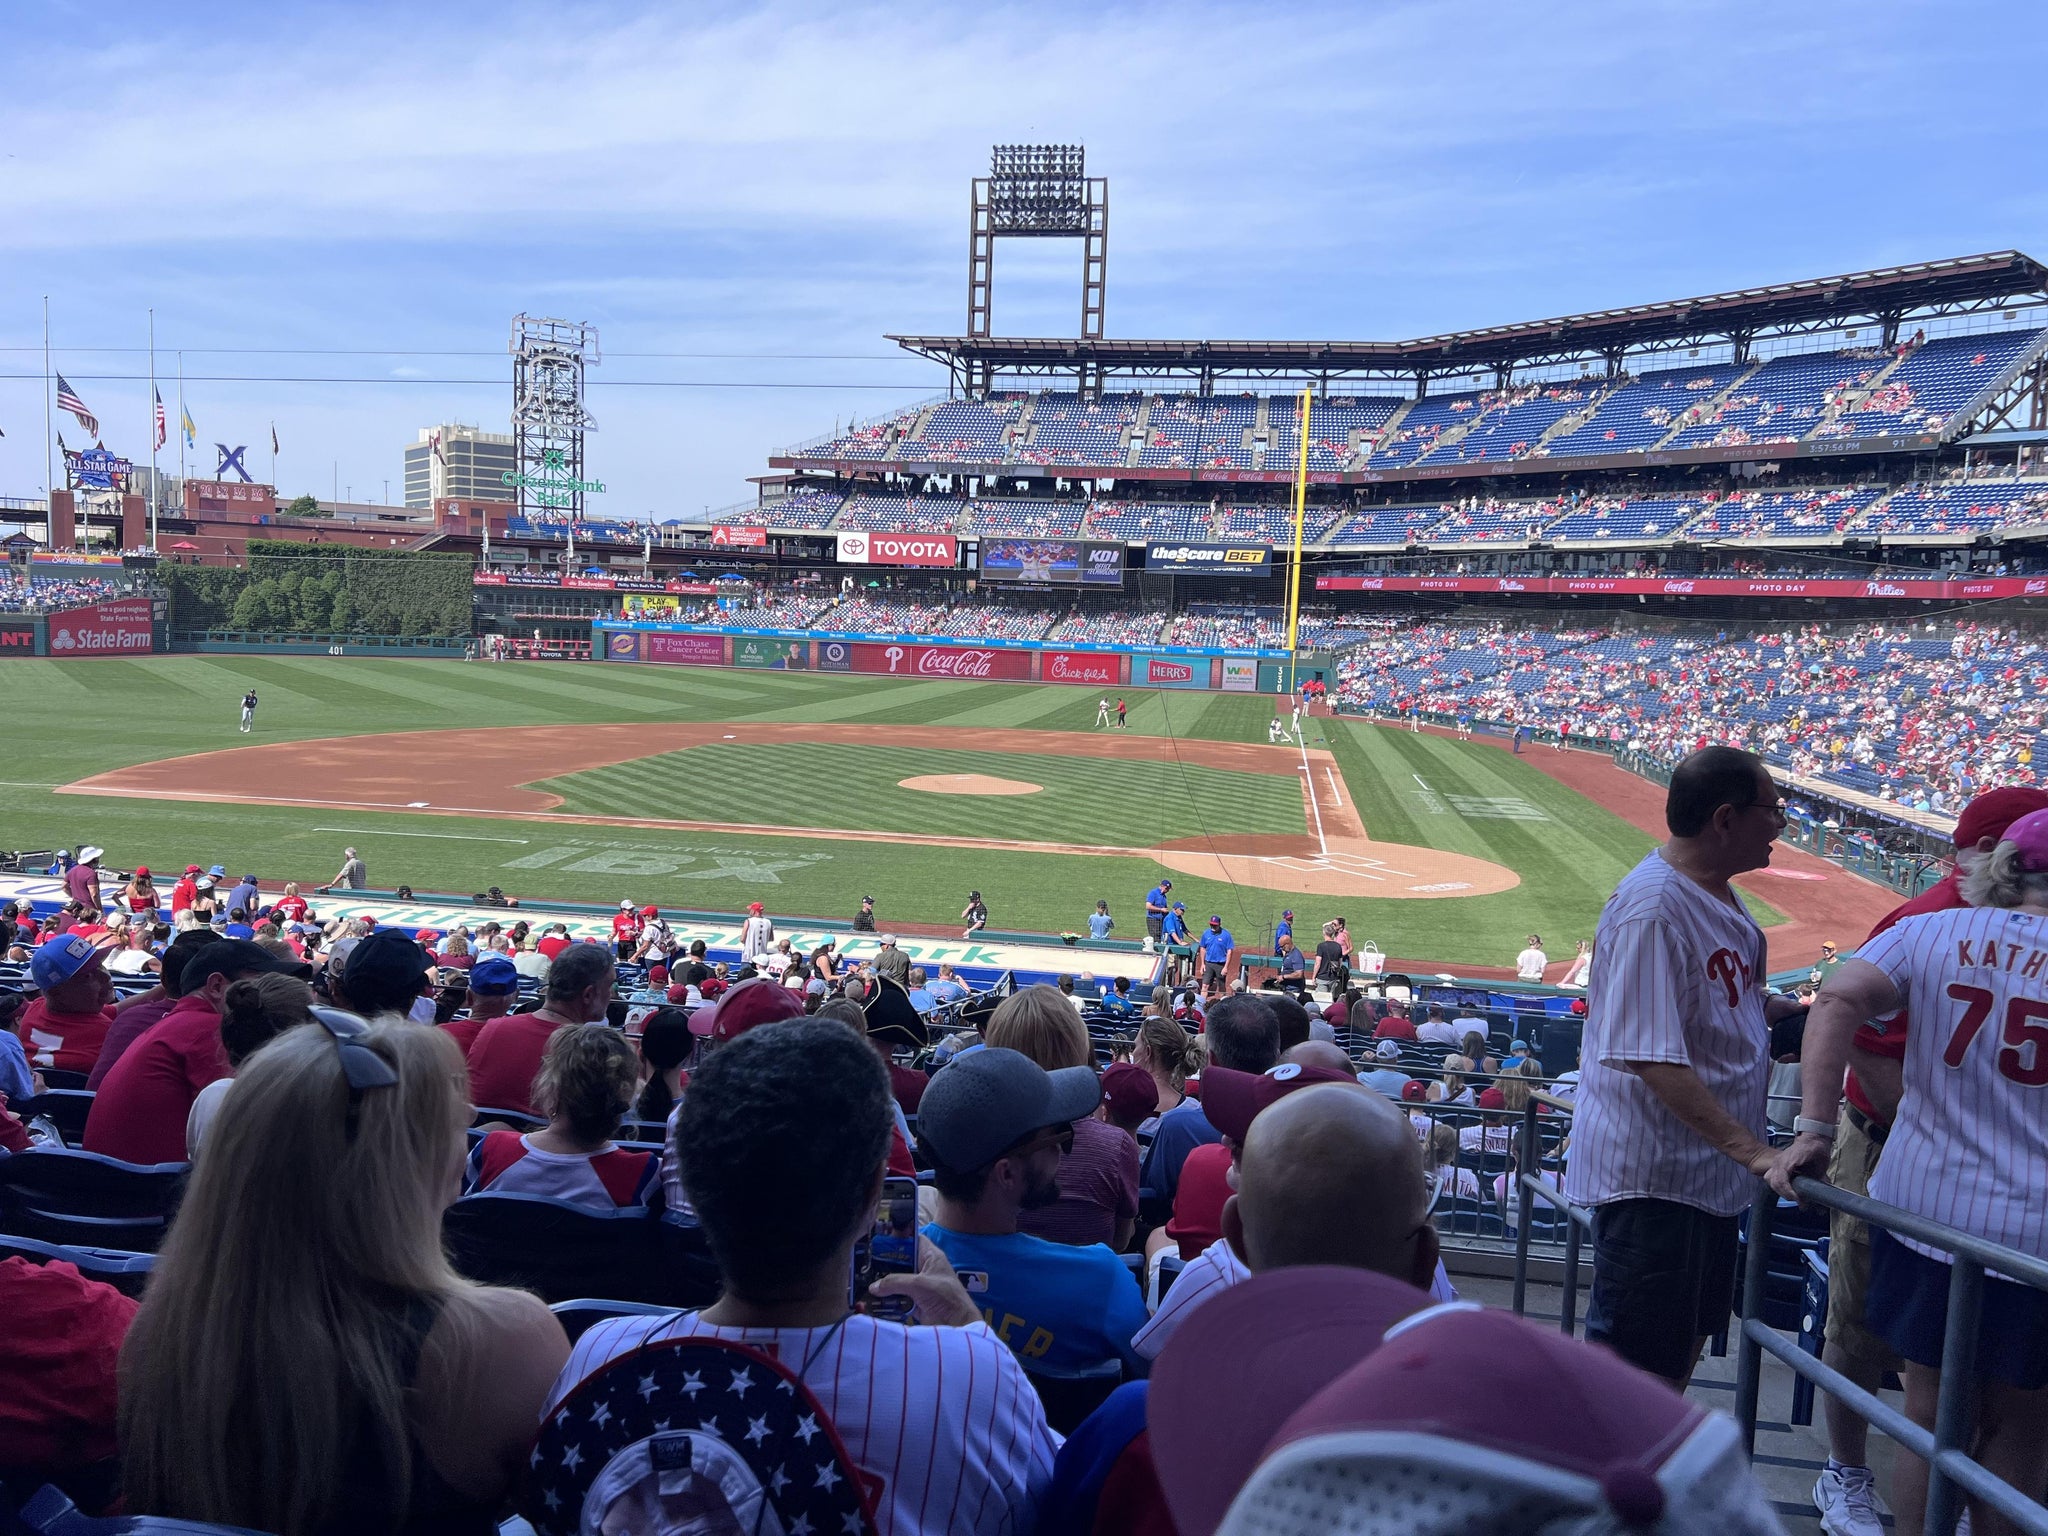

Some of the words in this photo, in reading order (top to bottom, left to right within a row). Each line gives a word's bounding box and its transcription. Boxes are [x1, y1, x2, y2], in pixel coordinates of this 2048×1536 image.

[1809, 443, 1844, 453] 3:57:56
[1846, 442, 1860, 451] PM
[65, 457, 83, 469] ALL
[84, 460, 106, 471] STAR
[107, 461, 132, 473] GAME
[502, 471, 564, 489] Citizens
[567, 477, 606, 493] Bank
[537, 492, 570, 507] Park
[873, 541, 948, 558] TOYOTA
[1089, 550, 1120, 562] KDI
[1152, 547, 1224, 561] theScore
[1229, 552, 1261, 561] BET
[578, 580, 609, 588] Budweiser
[1362, 579, 1384, 589] Coca-Cola
[1499, 578, 1525, 591] Phillies
[1664, 581, 1695, 592] Coca-Cola
[1749, 584, 1782, 592] PHOTO
[1785, 584, 1806, 592] DAY
[1866, 582, 1906, 596] Phillies
[1963, 585, 1980, 593] PHOTO
[667, 639, 682, 647] Fox
[683, 639, 710, 648] Chase
[328, 646, 343, 655] 401
[667, 646, 693, 654] Cancer
[694, 647, 720, 655] Center
[884, 647, 904, 673] P
[919, 648, 996, 677] Coca-Cola
[1052, 654, 1109, 681] Chick-fil-A
[1152, 666, 1187, 679] HERR'S
[1227, 667, 1253, 676] WM
[499, 846, 818, 884] IBX
[1943, 981, 2048, 1088] 75
